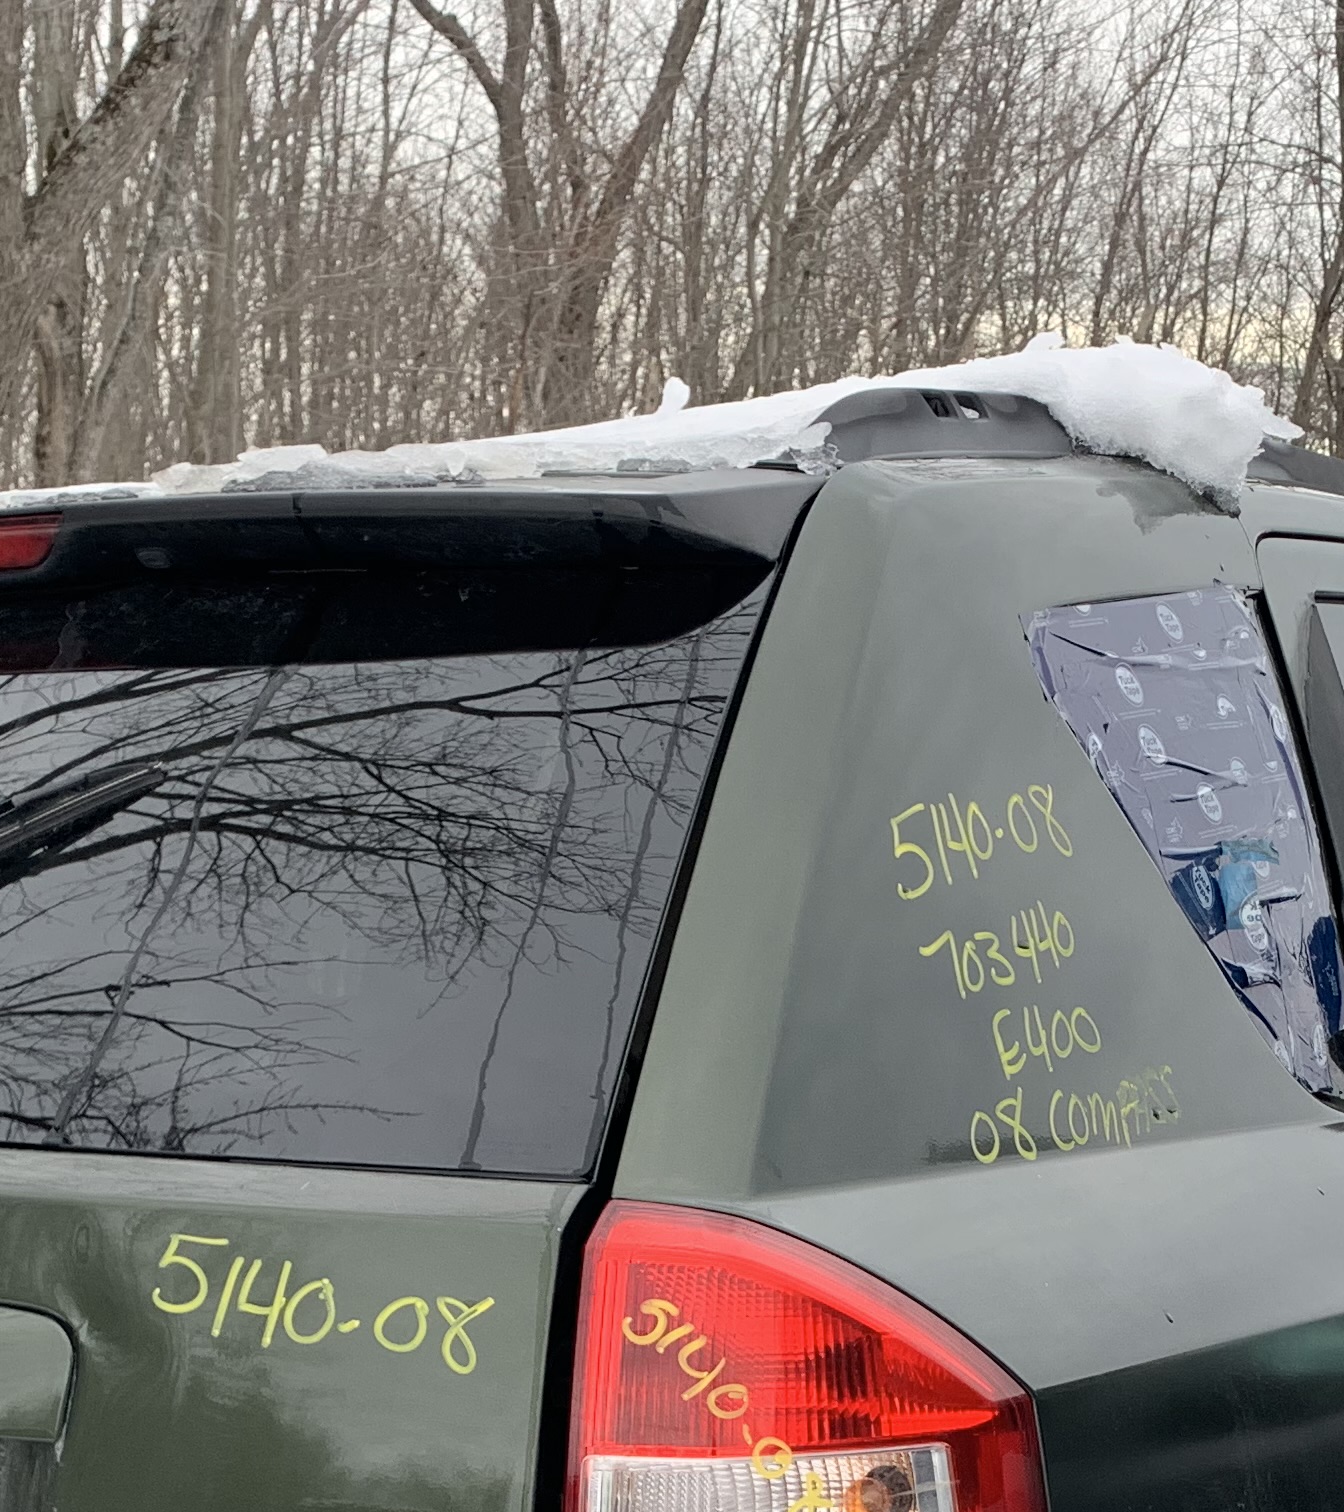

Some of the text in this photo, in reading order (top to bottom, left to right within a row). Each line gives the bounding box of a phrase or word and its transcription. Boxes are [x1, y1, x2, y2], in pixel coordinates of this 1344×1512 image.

[992, 1004, 1102, 1081] E400
[970, 1086, 1037, 1164] 08
[151, 1233, 495, 1375] 5140-08
